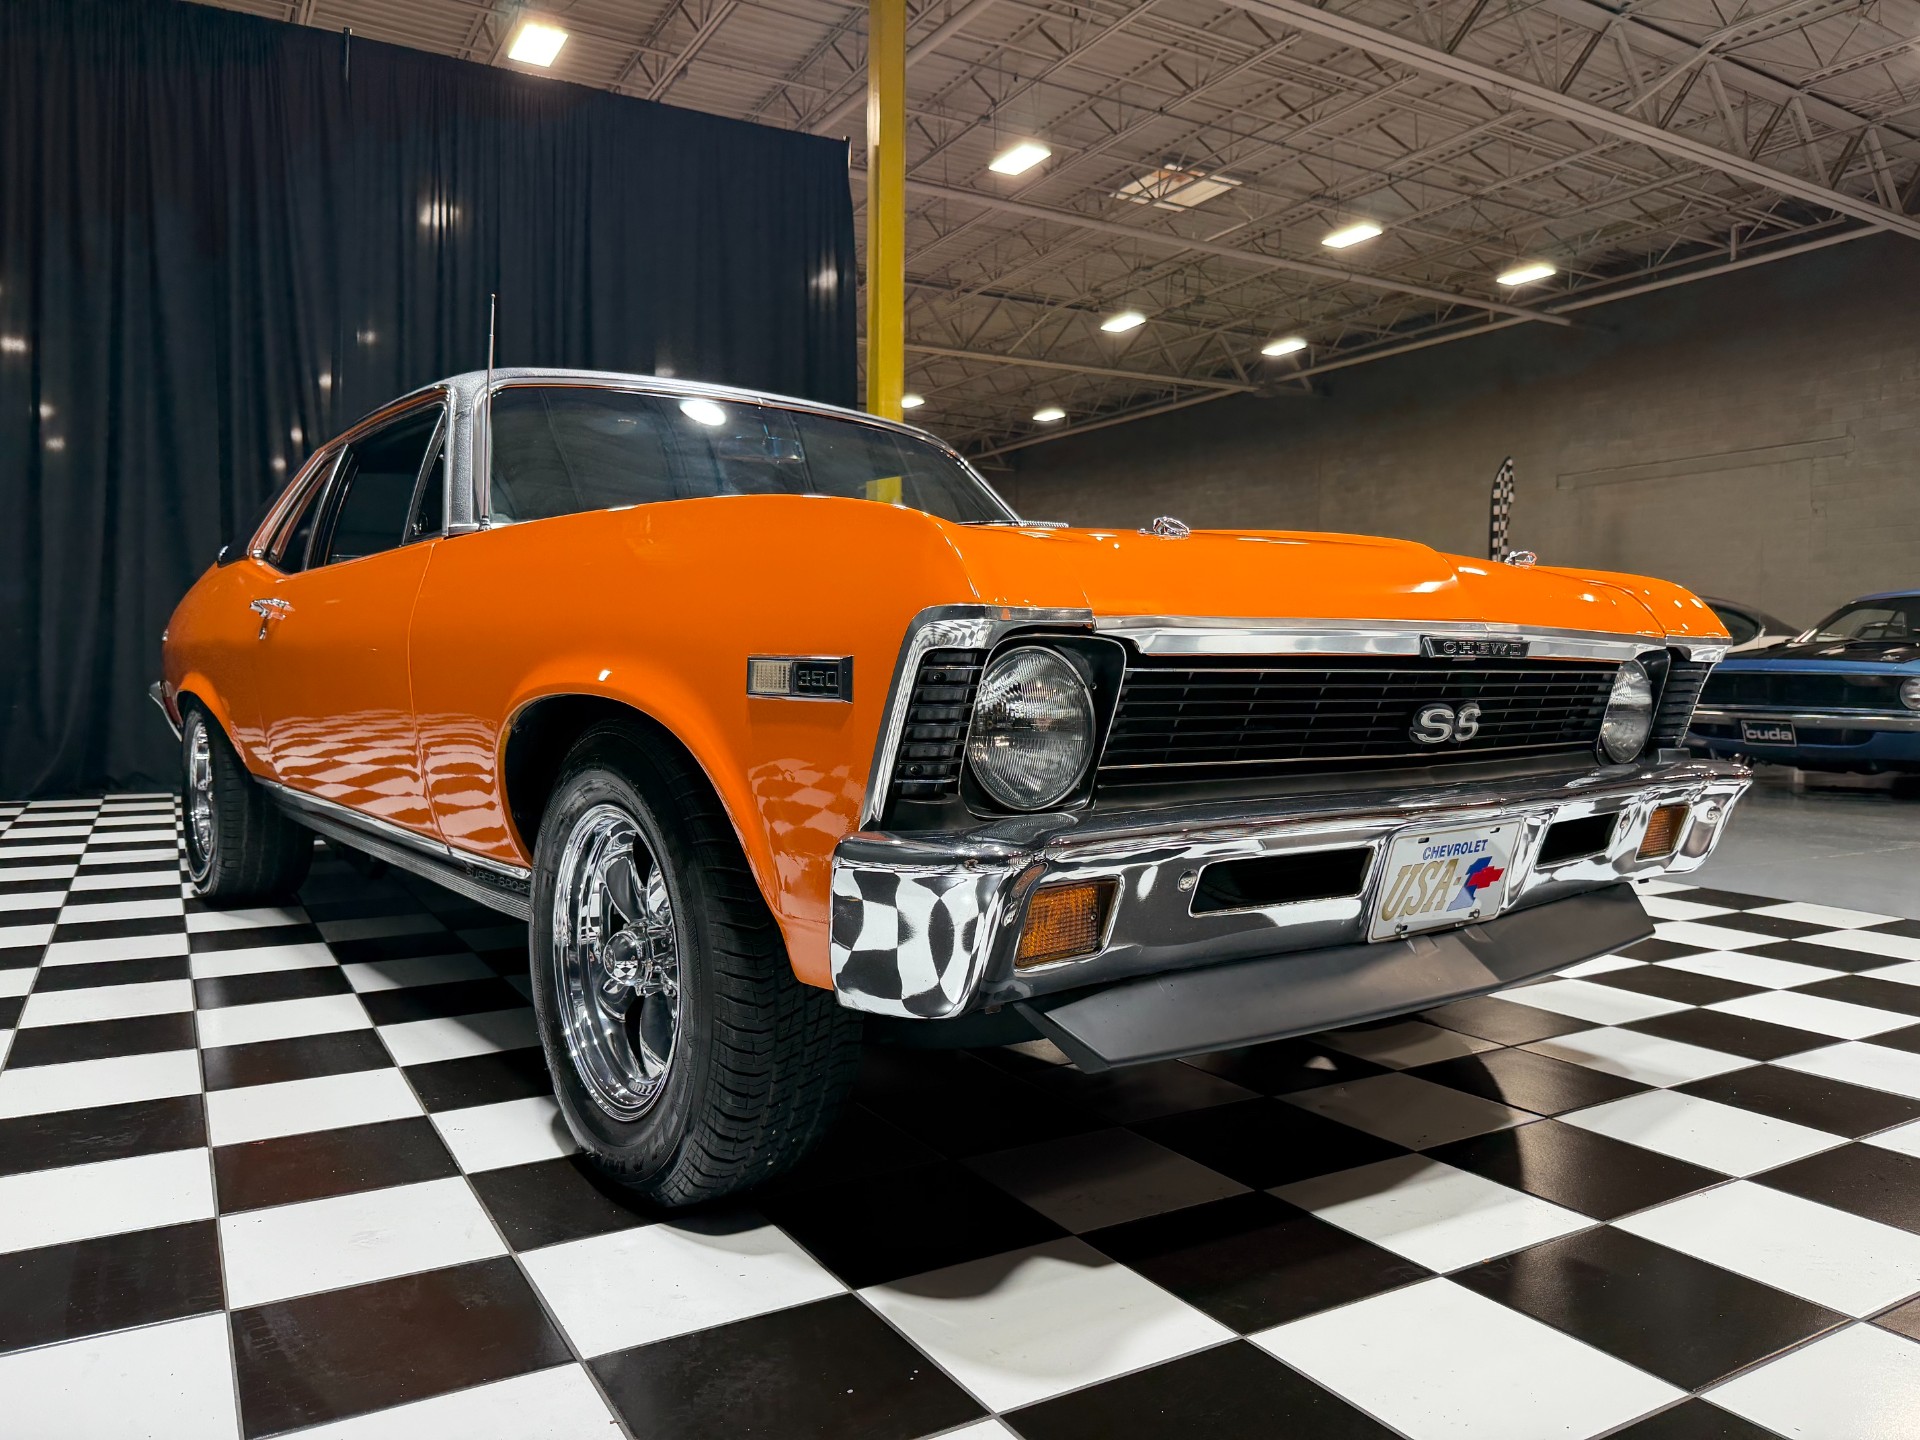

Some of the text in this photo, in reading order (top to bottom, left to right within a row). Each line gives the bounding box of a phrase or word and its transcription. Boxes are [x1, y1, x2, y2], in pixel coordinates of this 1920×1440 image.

[1443, 641, 1508, 656] CHEVY
[798, 670, 838, 687] 350
[1409, 703, 1481, 744] SS
[1423, 839, 1489, 860] CHEVROLET
